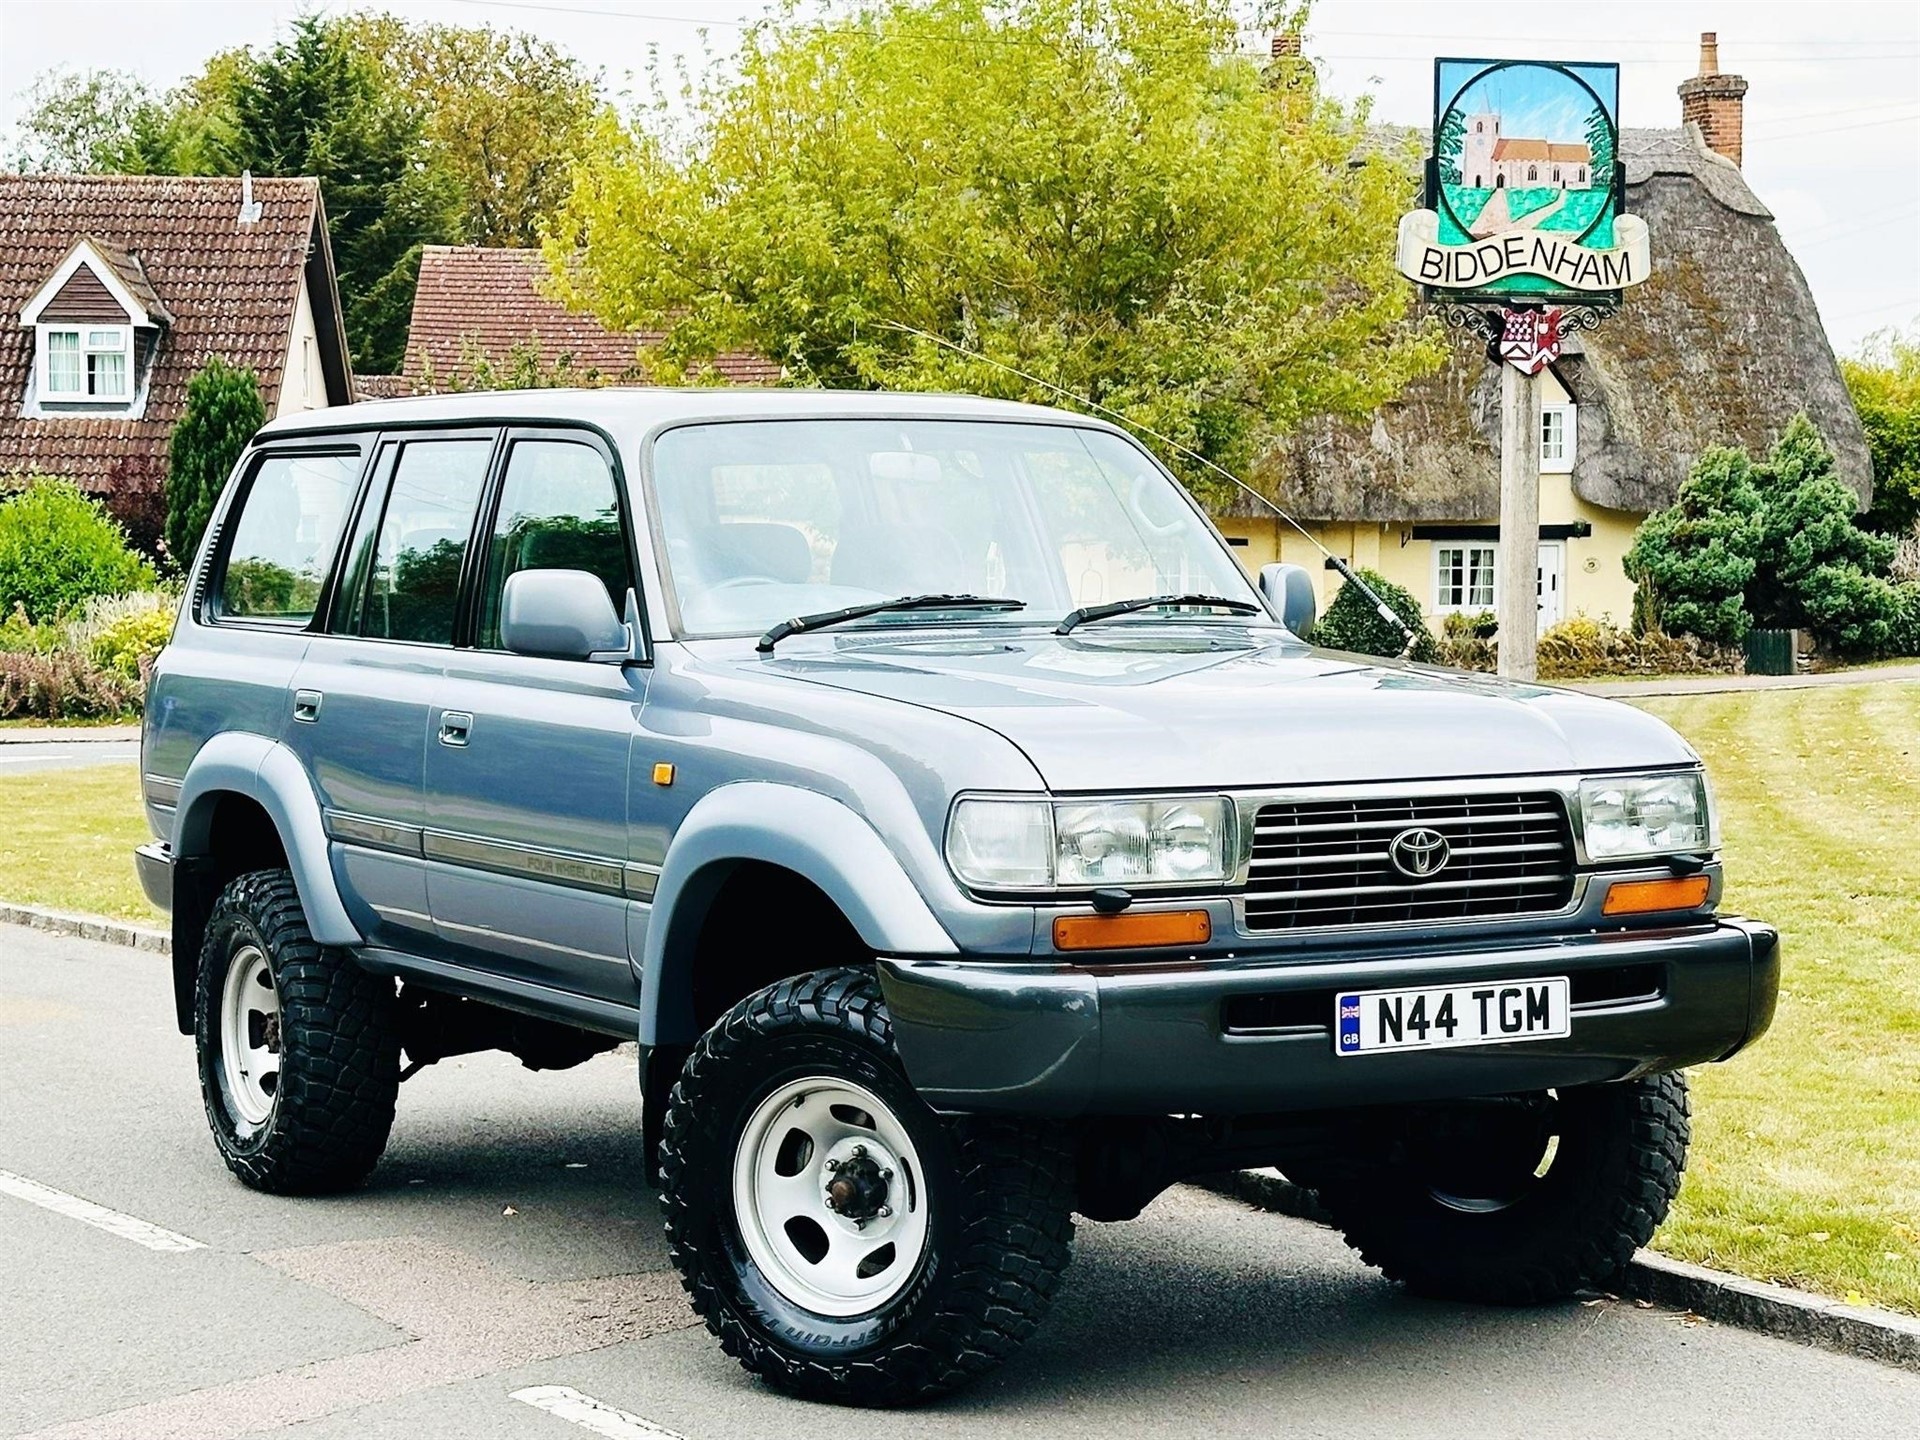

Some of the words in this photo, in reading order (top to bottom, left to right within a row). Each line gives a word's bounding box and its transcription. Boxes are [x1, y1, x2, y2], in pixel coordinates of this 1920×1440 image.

[1420, 236, 1632, 286] BIDDENHAM
[527, 857, 553, 873] FOUR
[555, 862, 589, 880] WHEEL
[591, 869, 620, 886] DRIVE
[1379, 993, 1458, 1044] N44
[1472, 986, 1550, 1035] TGM
[1342, 1033, 1360, 1046] GB
